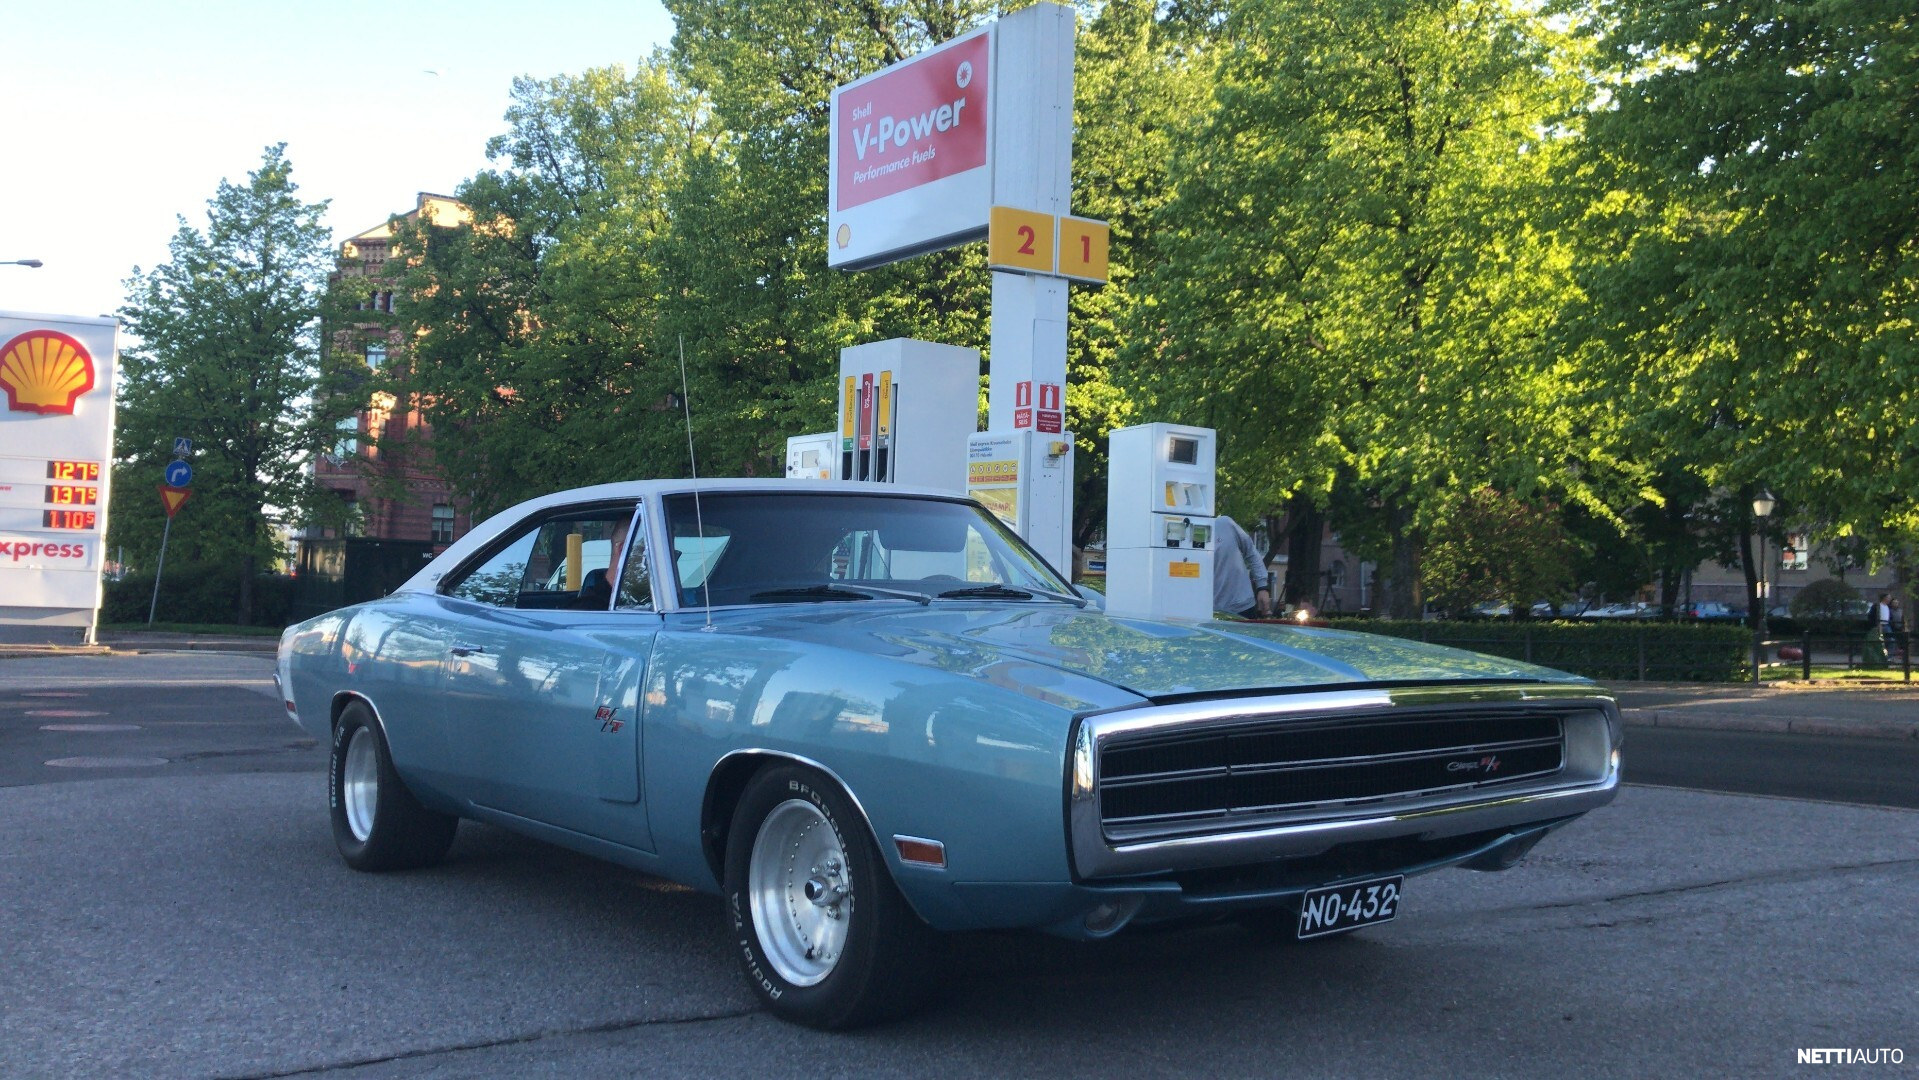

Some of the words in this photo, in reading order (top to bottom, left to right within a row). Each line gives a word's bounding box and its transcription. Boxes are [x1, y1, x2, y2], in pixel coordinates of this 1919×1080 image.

[852, 101, 871, 121] Shell
[852, 97, 966, 161] V-Power
[853, 158, 910, 184] Performance
[911, 144, 935, 165] Fuels
[1017, 225, 1035, 255] 2
[1081, 234, 1090, 263] 1
[595, 706, 625, 733] R/T
[732, 892, 743, 931] T/A
[1305, 884, 1397, 930] NO-432
[740, 939, 783, 1000] Radial
